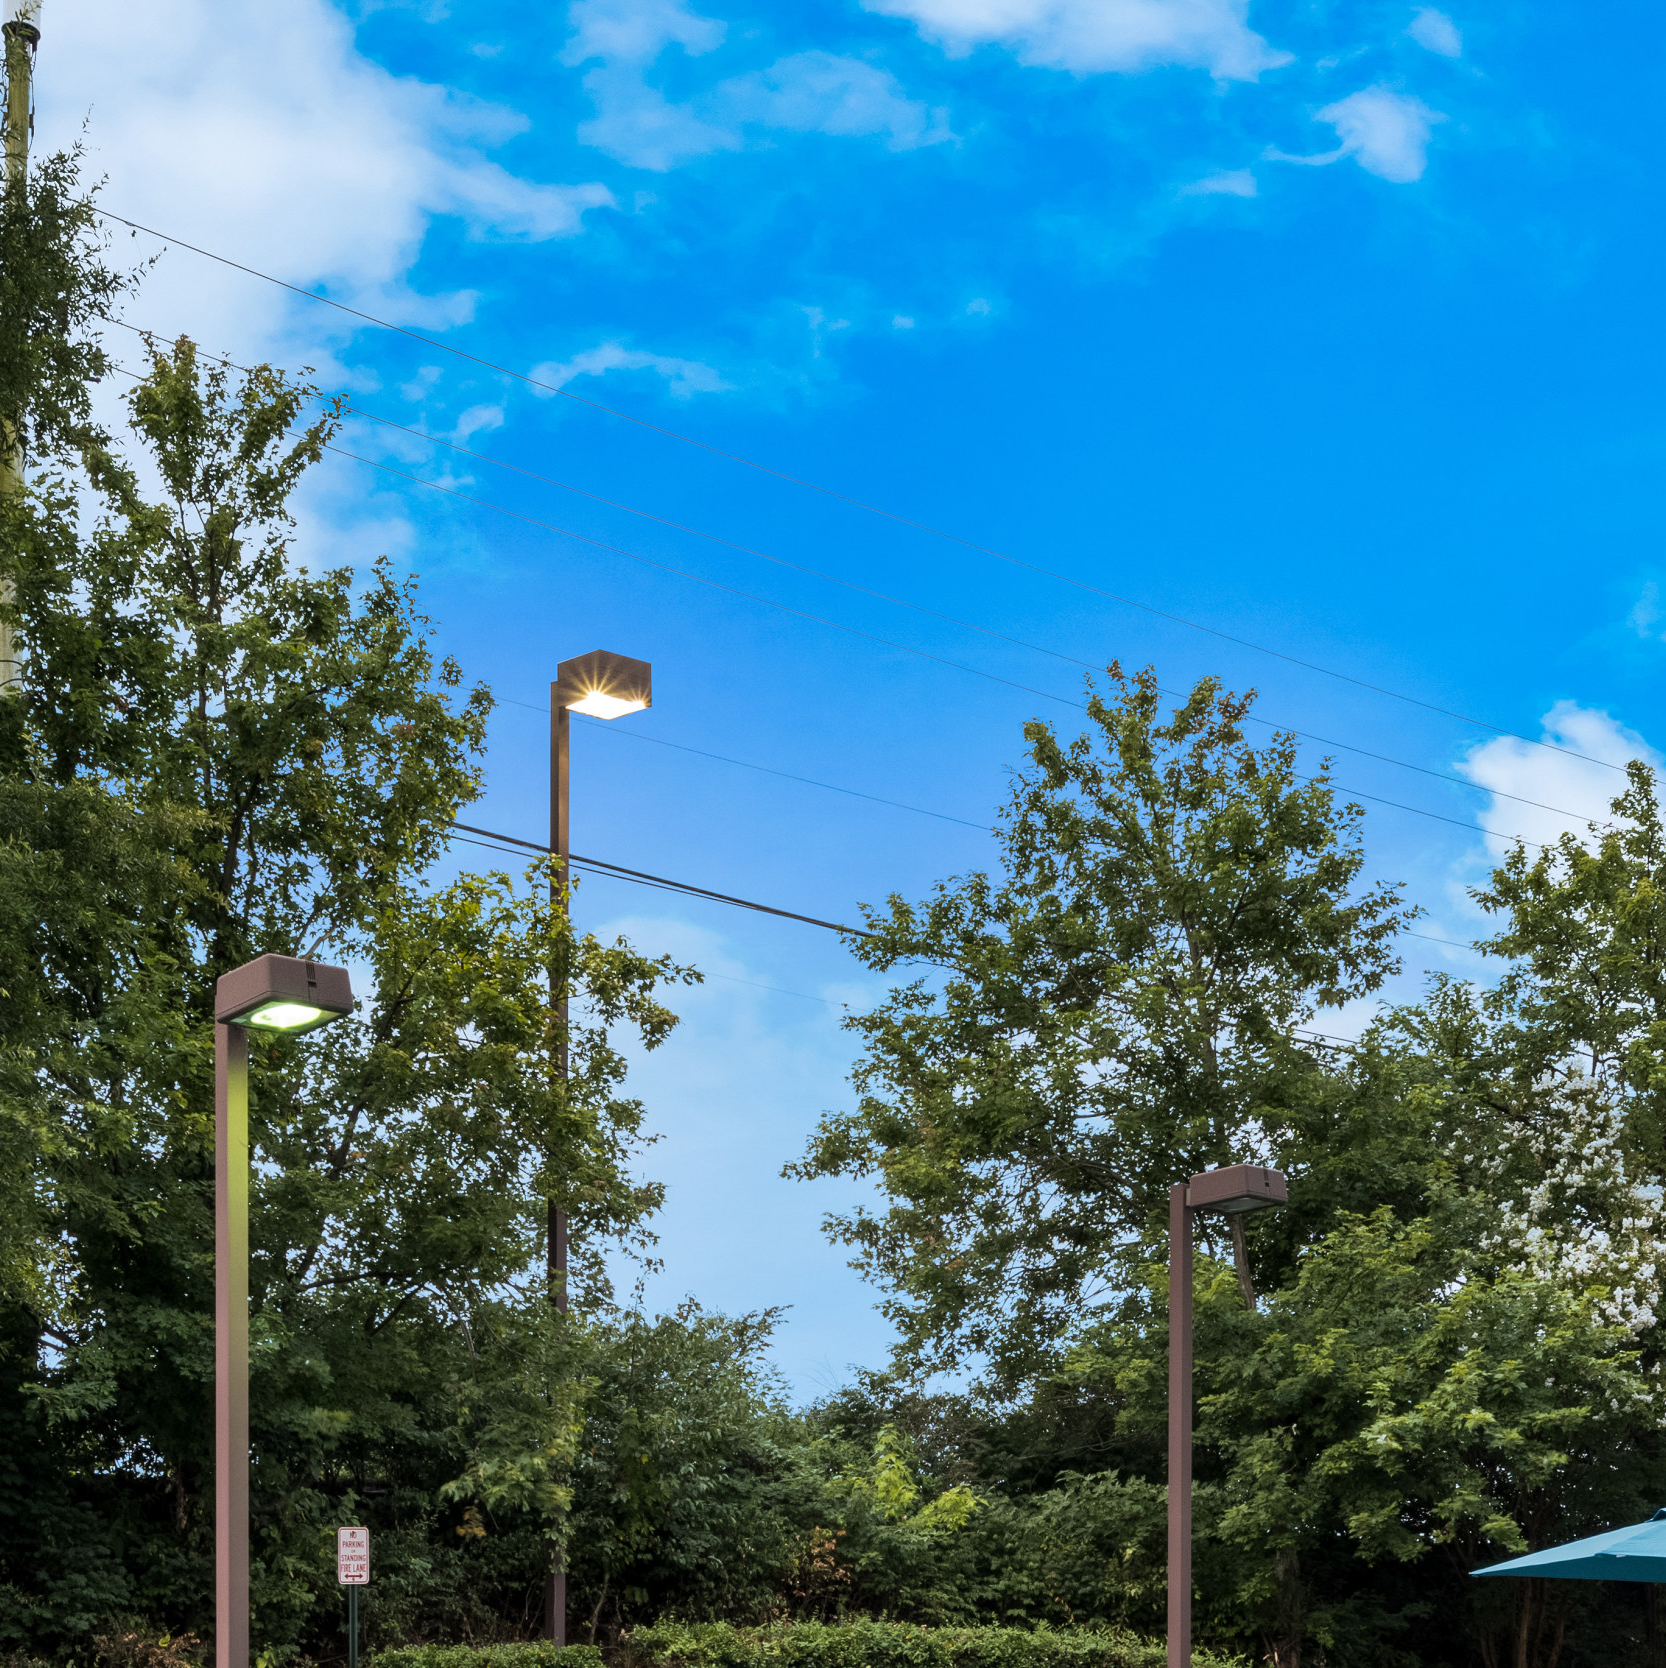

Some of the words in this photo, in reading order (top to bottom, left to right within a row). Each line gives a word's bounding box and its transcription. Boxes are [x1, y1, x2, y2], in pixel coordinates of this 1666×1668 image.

[350, 1531, 357, 1539] NO
[341, 1554, 366, 1562] STANDING
[341, 1563, 351, 1573] FIRE
[353, 1563, 366, 1573] LANE
